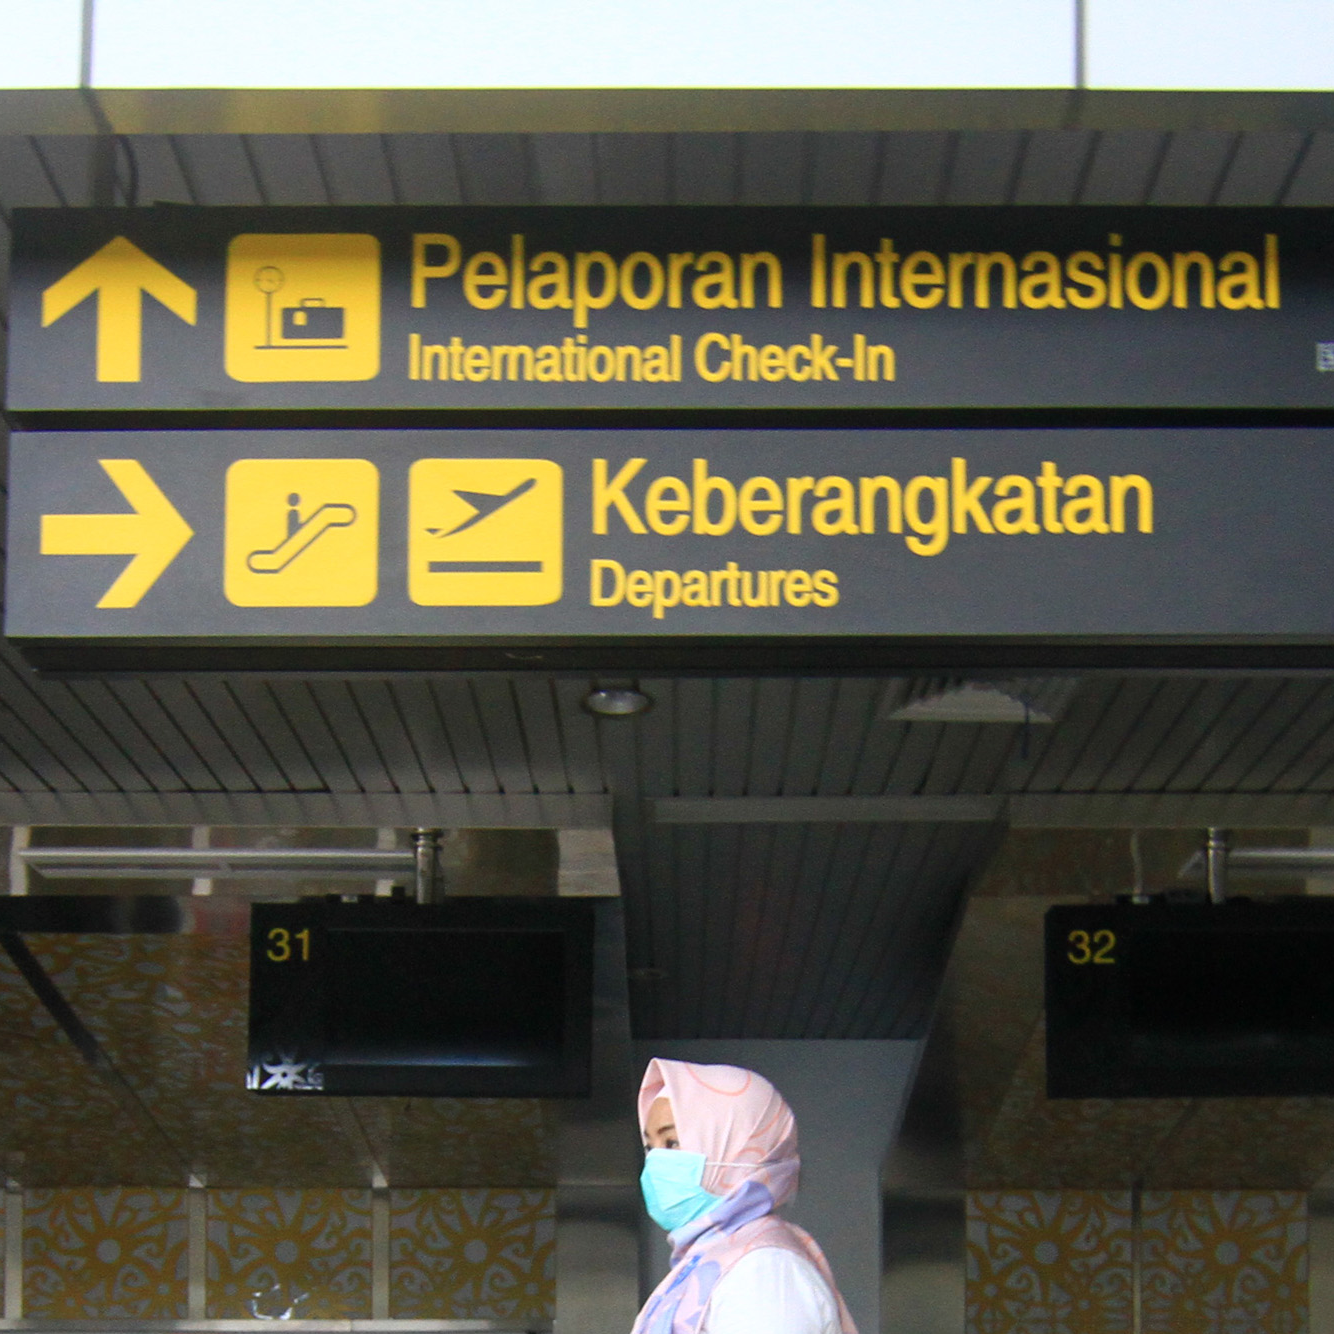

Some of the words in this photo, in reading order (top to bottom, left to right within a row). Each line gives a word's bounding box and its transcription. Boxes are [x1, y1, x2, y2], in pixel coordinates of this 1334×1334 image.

[410, 232, 784, 329] Pelaporan
[810, 234, 1281, 311] Internasional
[408, 332, 683, 383] International
[693, 332, 897, 383] Check-In
[591, 456, 1155, 558] Keberangkatan
[589, 558, 841, 620] Departures
[267, 927, 310, 962] 31
[1067, 929, 1117, 966] 32
